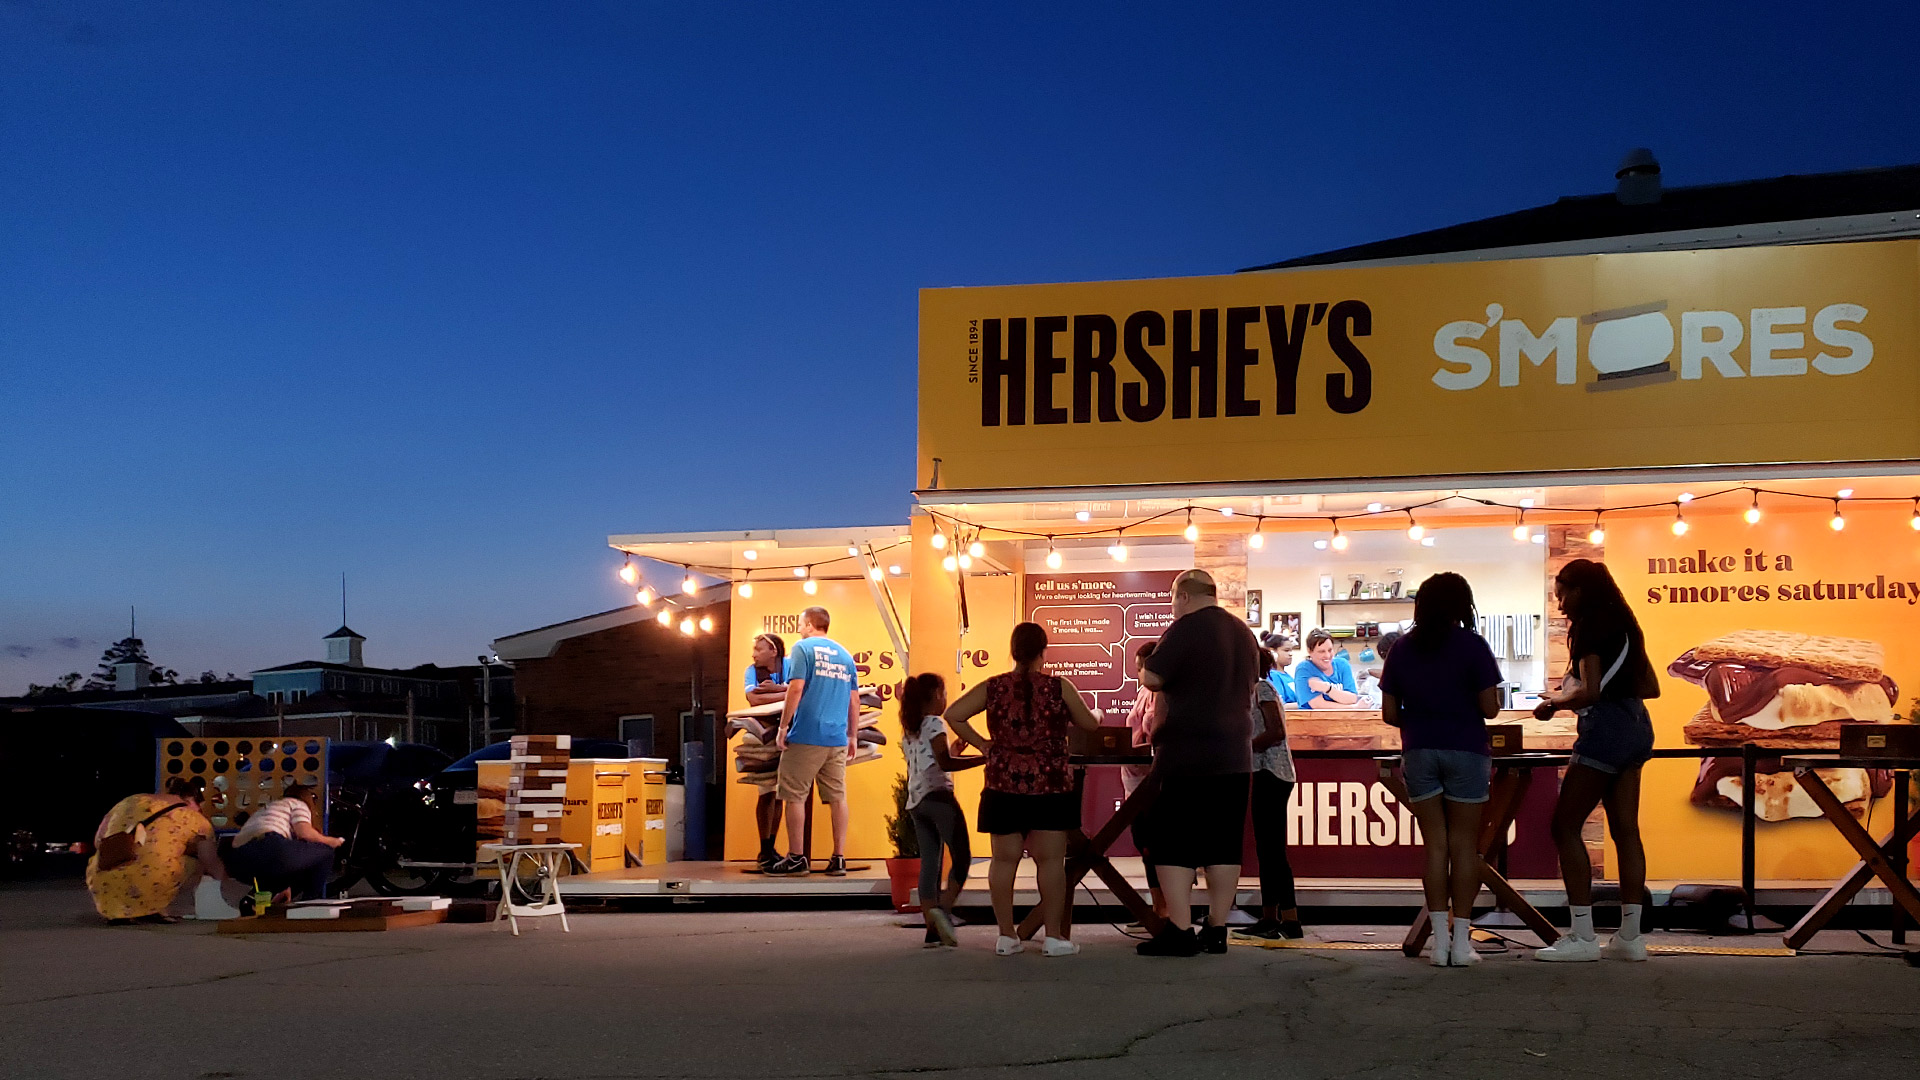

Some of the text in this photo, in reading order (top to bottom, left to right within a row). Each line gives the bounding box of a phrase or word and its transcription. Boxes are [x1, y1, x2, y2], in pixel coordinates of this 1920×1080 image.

[968, 319, 978, 384] SINCE 1894
[981, 300, 1372, 426] HERSHEY'S
[1648, 548, 1794, 574] make it a
[1035, 580, 1116, 590] tell us s'more.
[1078, 592, 1101, 600] looking
[1648, 575, 1920, 606] s'mores saturday
[1074, 661, 1097, 669] special
